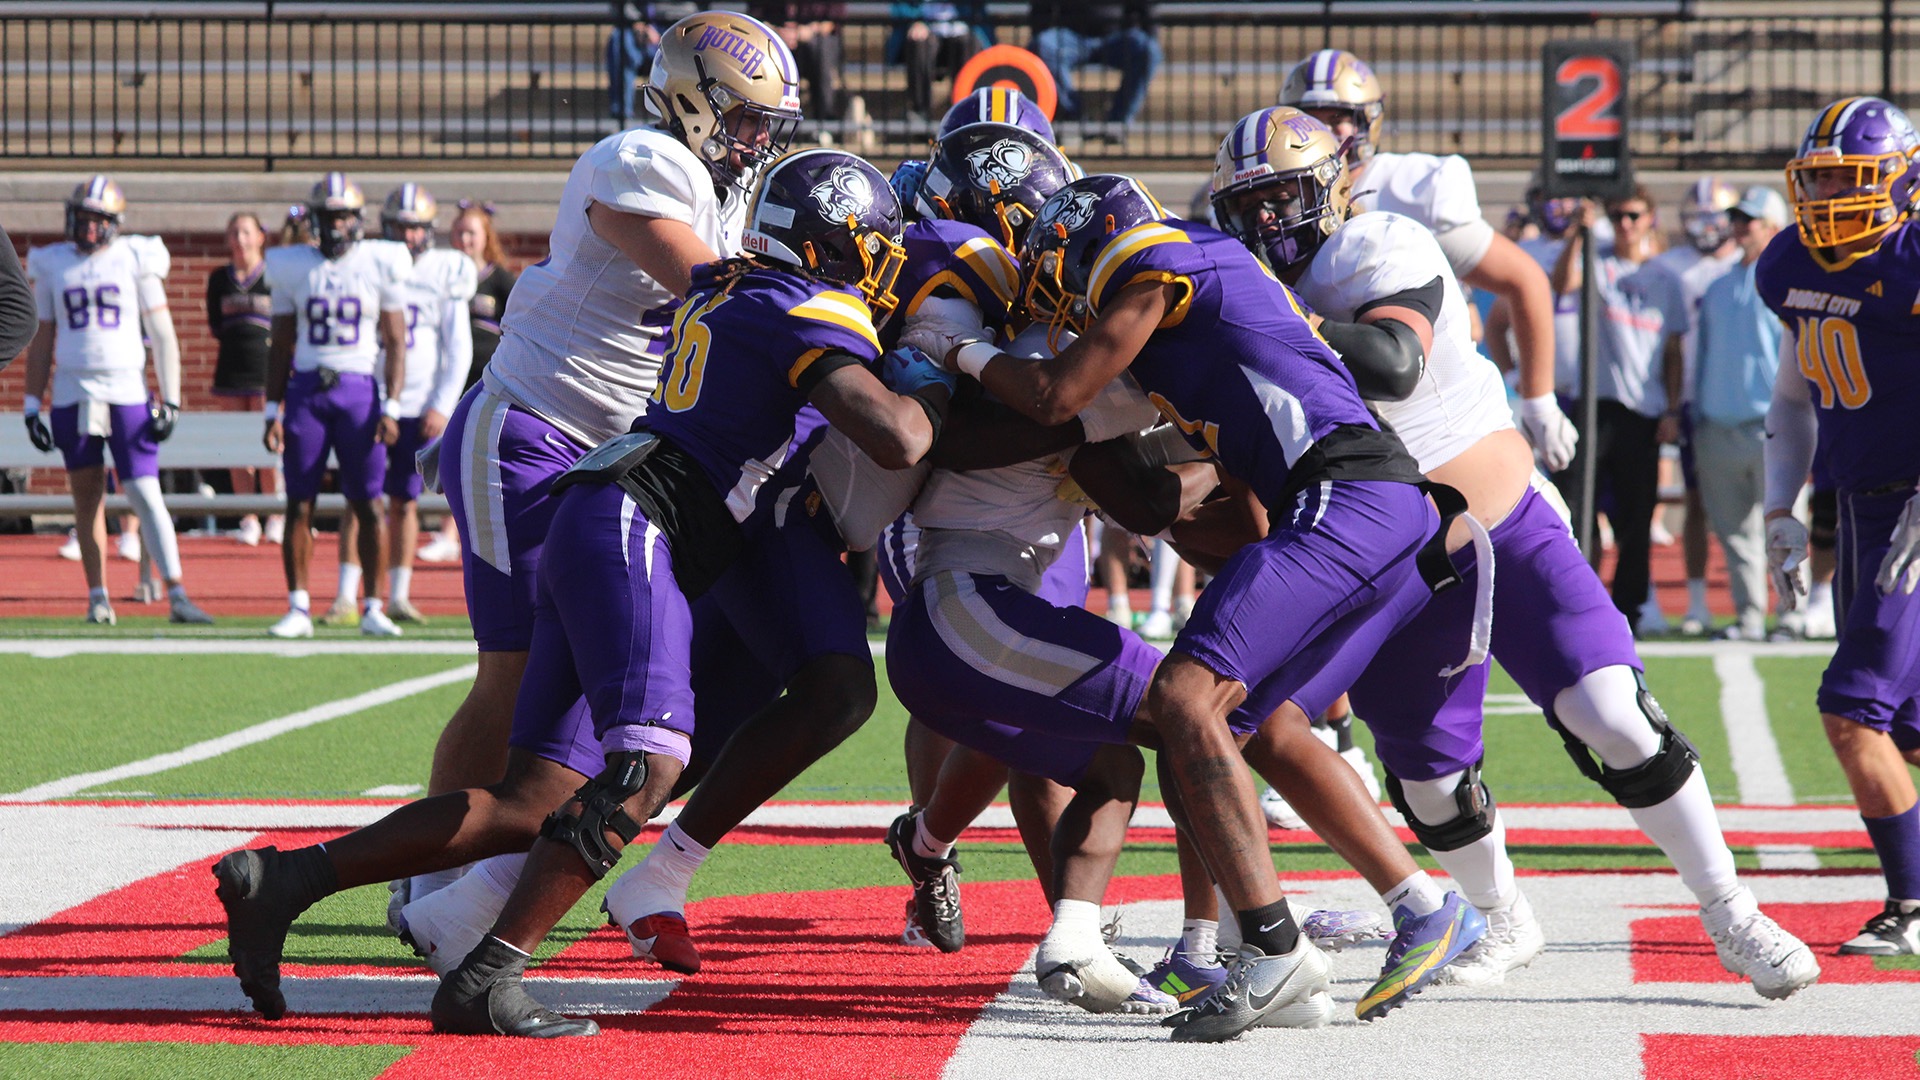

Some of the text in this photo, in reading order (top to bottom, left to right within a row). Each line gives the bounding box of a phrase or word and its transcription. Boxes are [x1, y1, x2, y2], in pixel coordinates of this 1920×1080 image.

[693, 25, 765, 80] BUTLER
[1554, 56, 1621, 140] 2
[1235, 168, 1266, 181] Riddell
[63, 285, 121, 330] 86
[306, 296, 362, 346] 89
[1827, 295, 1861, 317] CITY
[1795, 316, 1872, 410] 40
